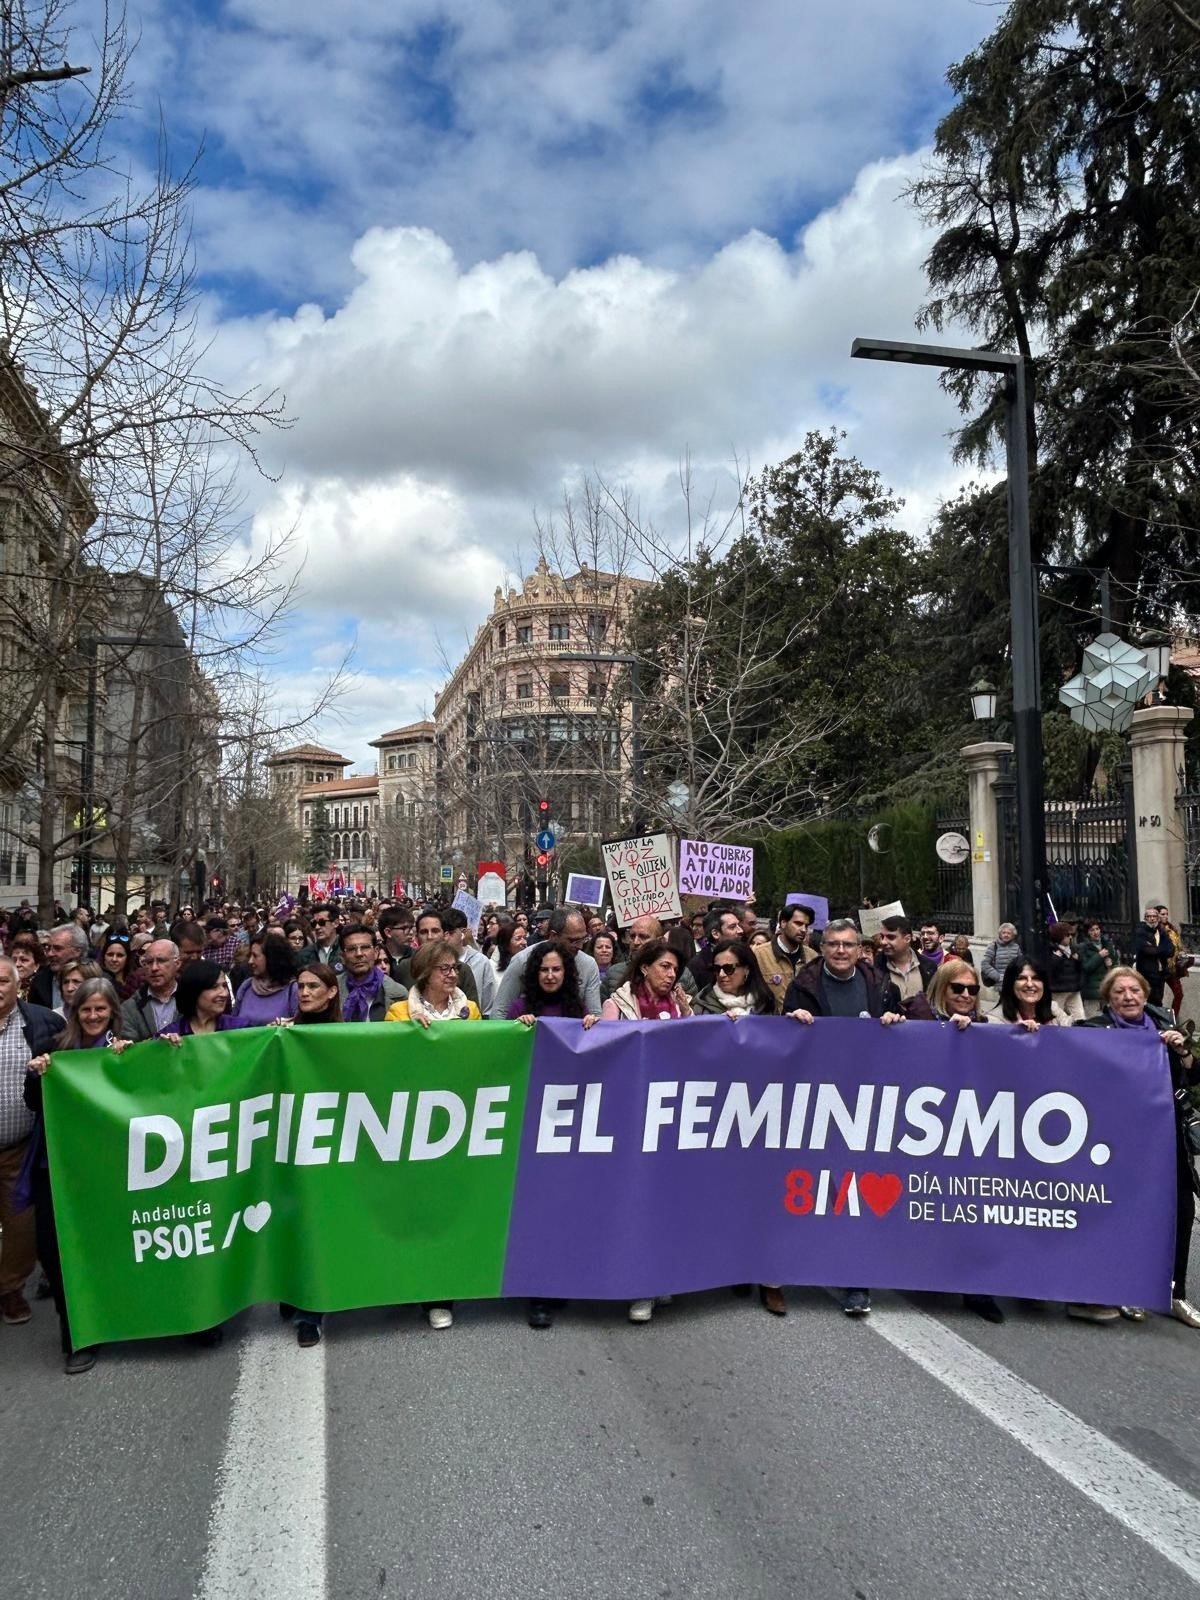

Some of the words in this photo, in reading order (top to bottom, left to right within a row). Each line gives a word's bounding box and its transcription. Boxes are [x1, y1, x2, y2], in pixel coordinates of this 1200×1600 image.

[1150, 815, 1161, 827] 50
[604, 843, 621, 853] HOY
[624, 840, 638, 849] SOY
[642, 838, 654, 846] LA
[687, 842, 708, 857] NO
[712, 846, 752, 862] CUBRAS
[610, 847, 659, 870] VOZ
[611, 870, 626, 880] DE
[636, 856, 667, 876] QUIEN
[686, 858, 696, 872] A
[717, 861, 751, 878] AMIGO
[689, 874, 750, 896] VIOLADOR
[127, 1085, 511, 1192] DEFIENDE
[535, 1082, 614, 1153] EL
[642, 1081, 1111, 1165] FEMINISMO.
[908, 1171, 942, 1195] DÍA
[949, 1176, 1112, 1204] INTERNACIONAL
[131, 1199, 211, 1225] Andalucía
[909, 1201, 935, 1221] DE
[942, 1203, 978, 1224] LAS
[983, 1204, 1078, 1229] MUJERES
[132, 1220, 215, 1263] PSOE
